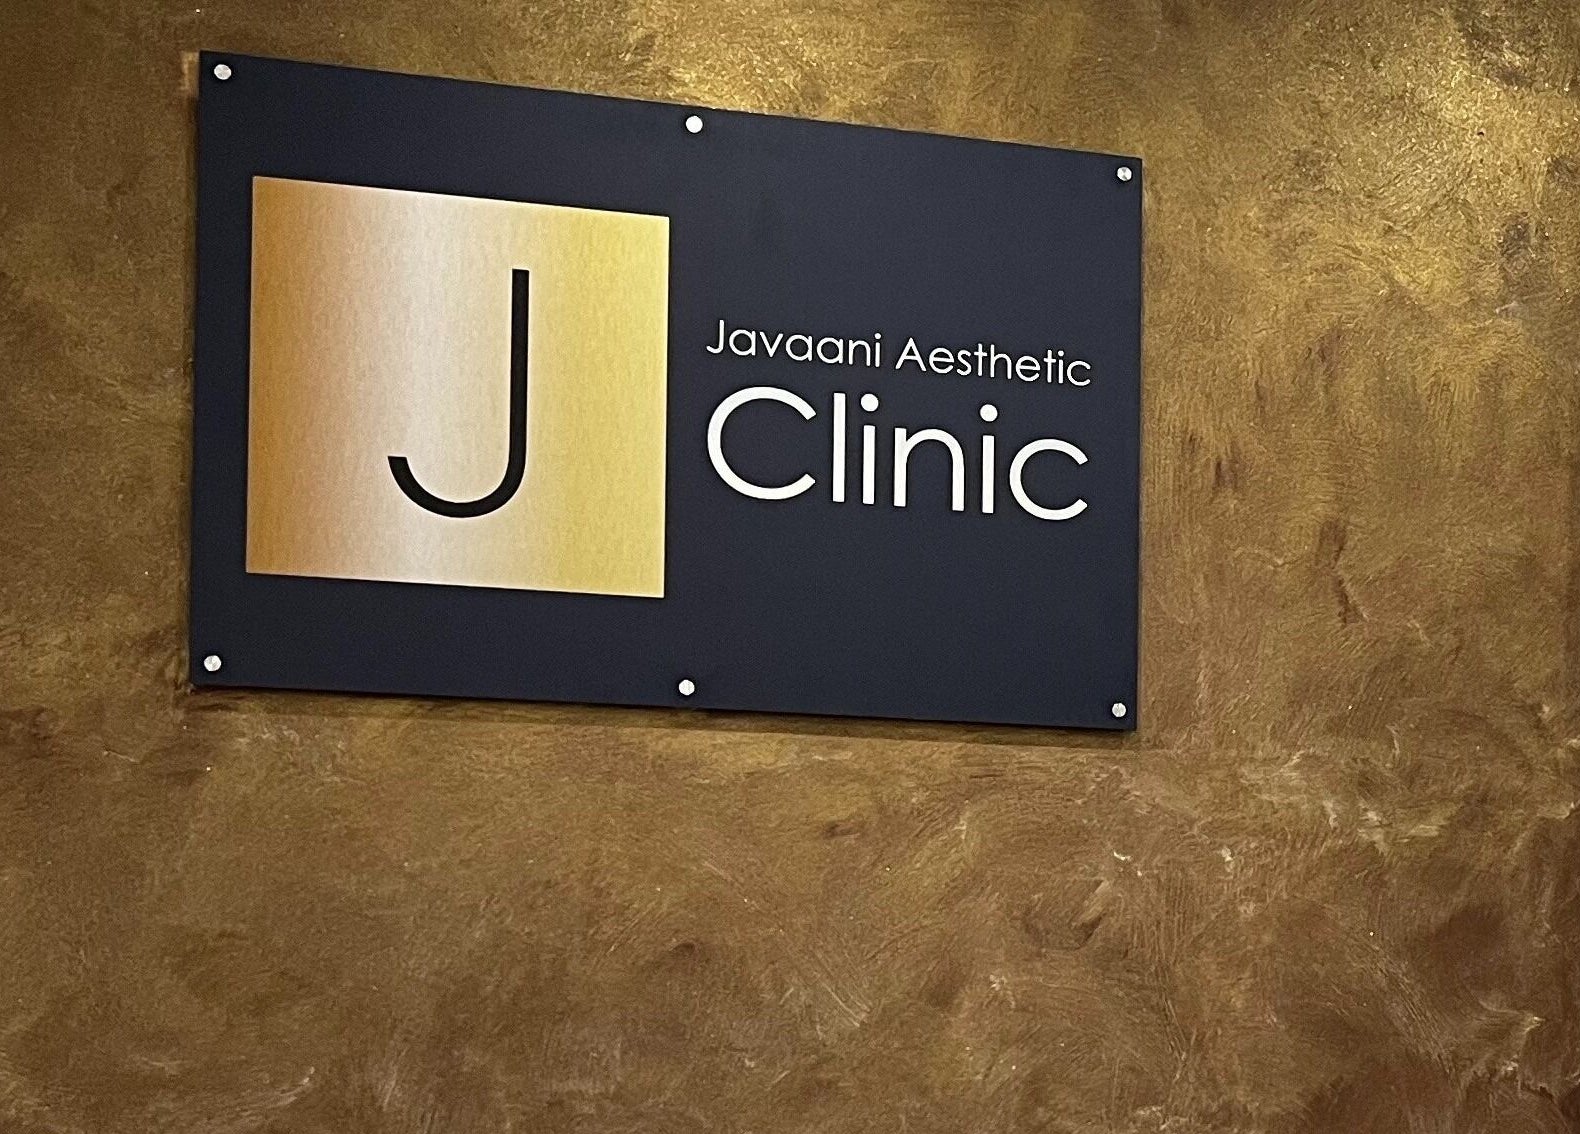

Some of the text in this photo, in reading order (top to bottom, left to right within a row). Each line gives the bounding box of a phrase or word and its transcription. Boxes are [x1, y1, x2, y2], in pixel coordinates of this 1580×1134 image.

[387, 268, 530, 518] J
[706, 319, 1091, 387] Javaani Aesthetic
[707, 386, 1088, 520] Clinic
